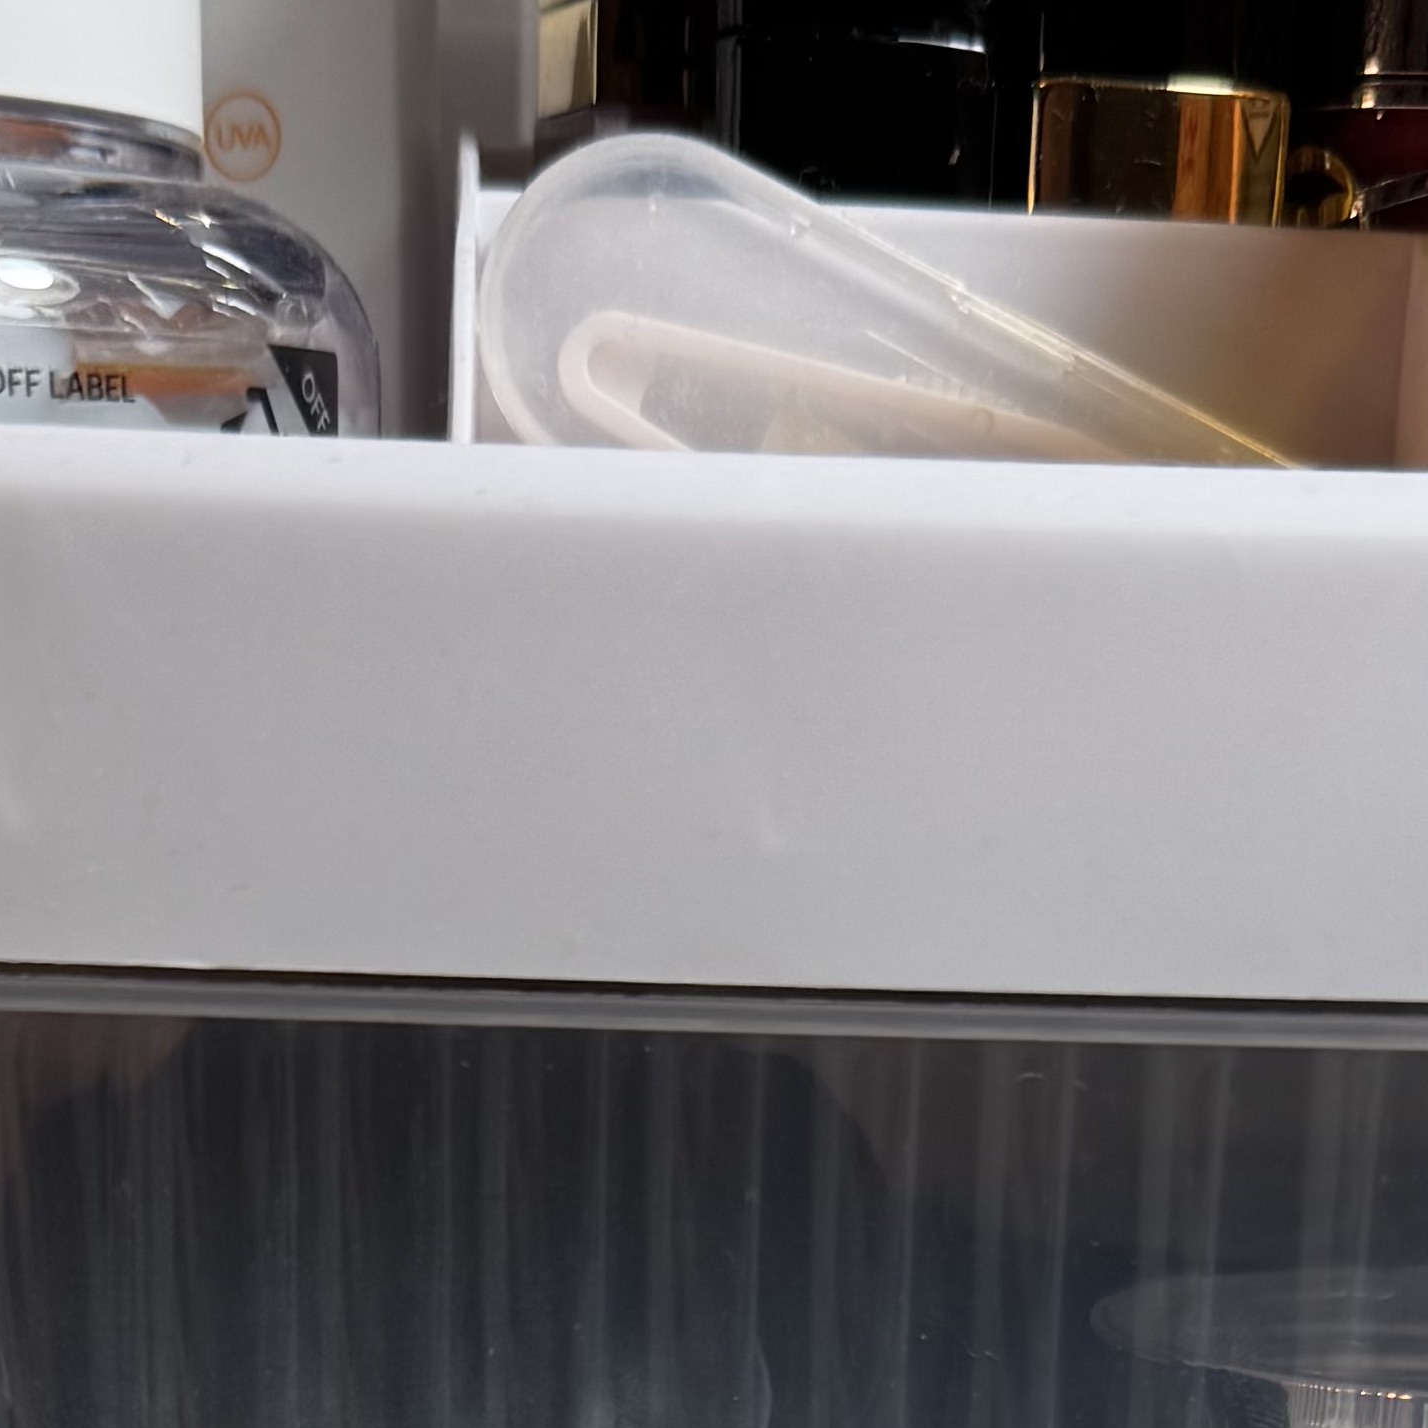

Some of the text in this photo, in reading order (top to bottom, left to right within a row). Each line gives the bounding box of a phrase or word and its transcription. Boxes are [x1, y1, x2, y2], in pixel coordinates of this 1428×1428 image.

[217, 122, 270, 151] UVA
[49, 367, 137, 404] LABEL
[302, 372, 330, 431] OFF
